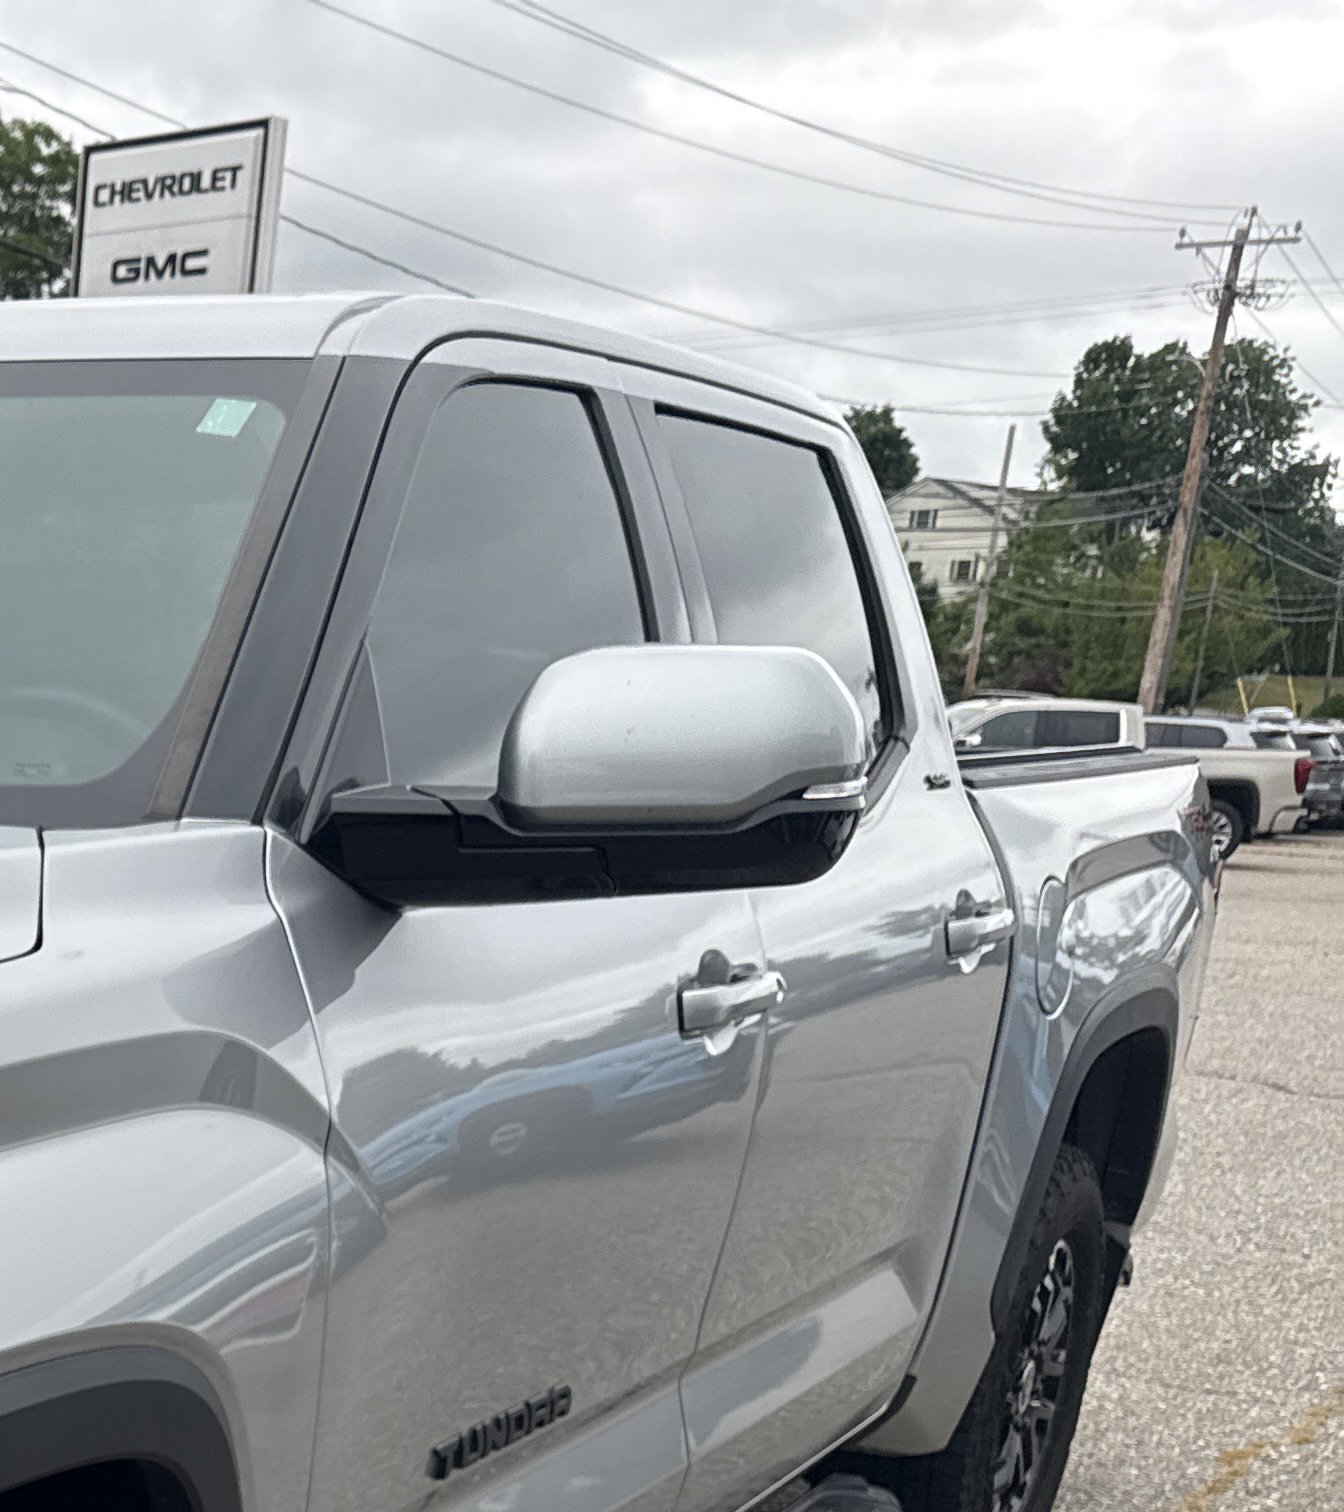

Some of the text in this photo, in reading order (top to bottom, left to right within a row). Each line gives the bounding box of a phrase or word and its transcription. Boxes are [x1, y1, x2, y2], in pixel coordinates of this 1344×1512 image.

[92, 163, 244, 209] CHEVROLET
[111, 248, 210, 286] GMC
[424, 1384, 573, 1480] TUNDRA
